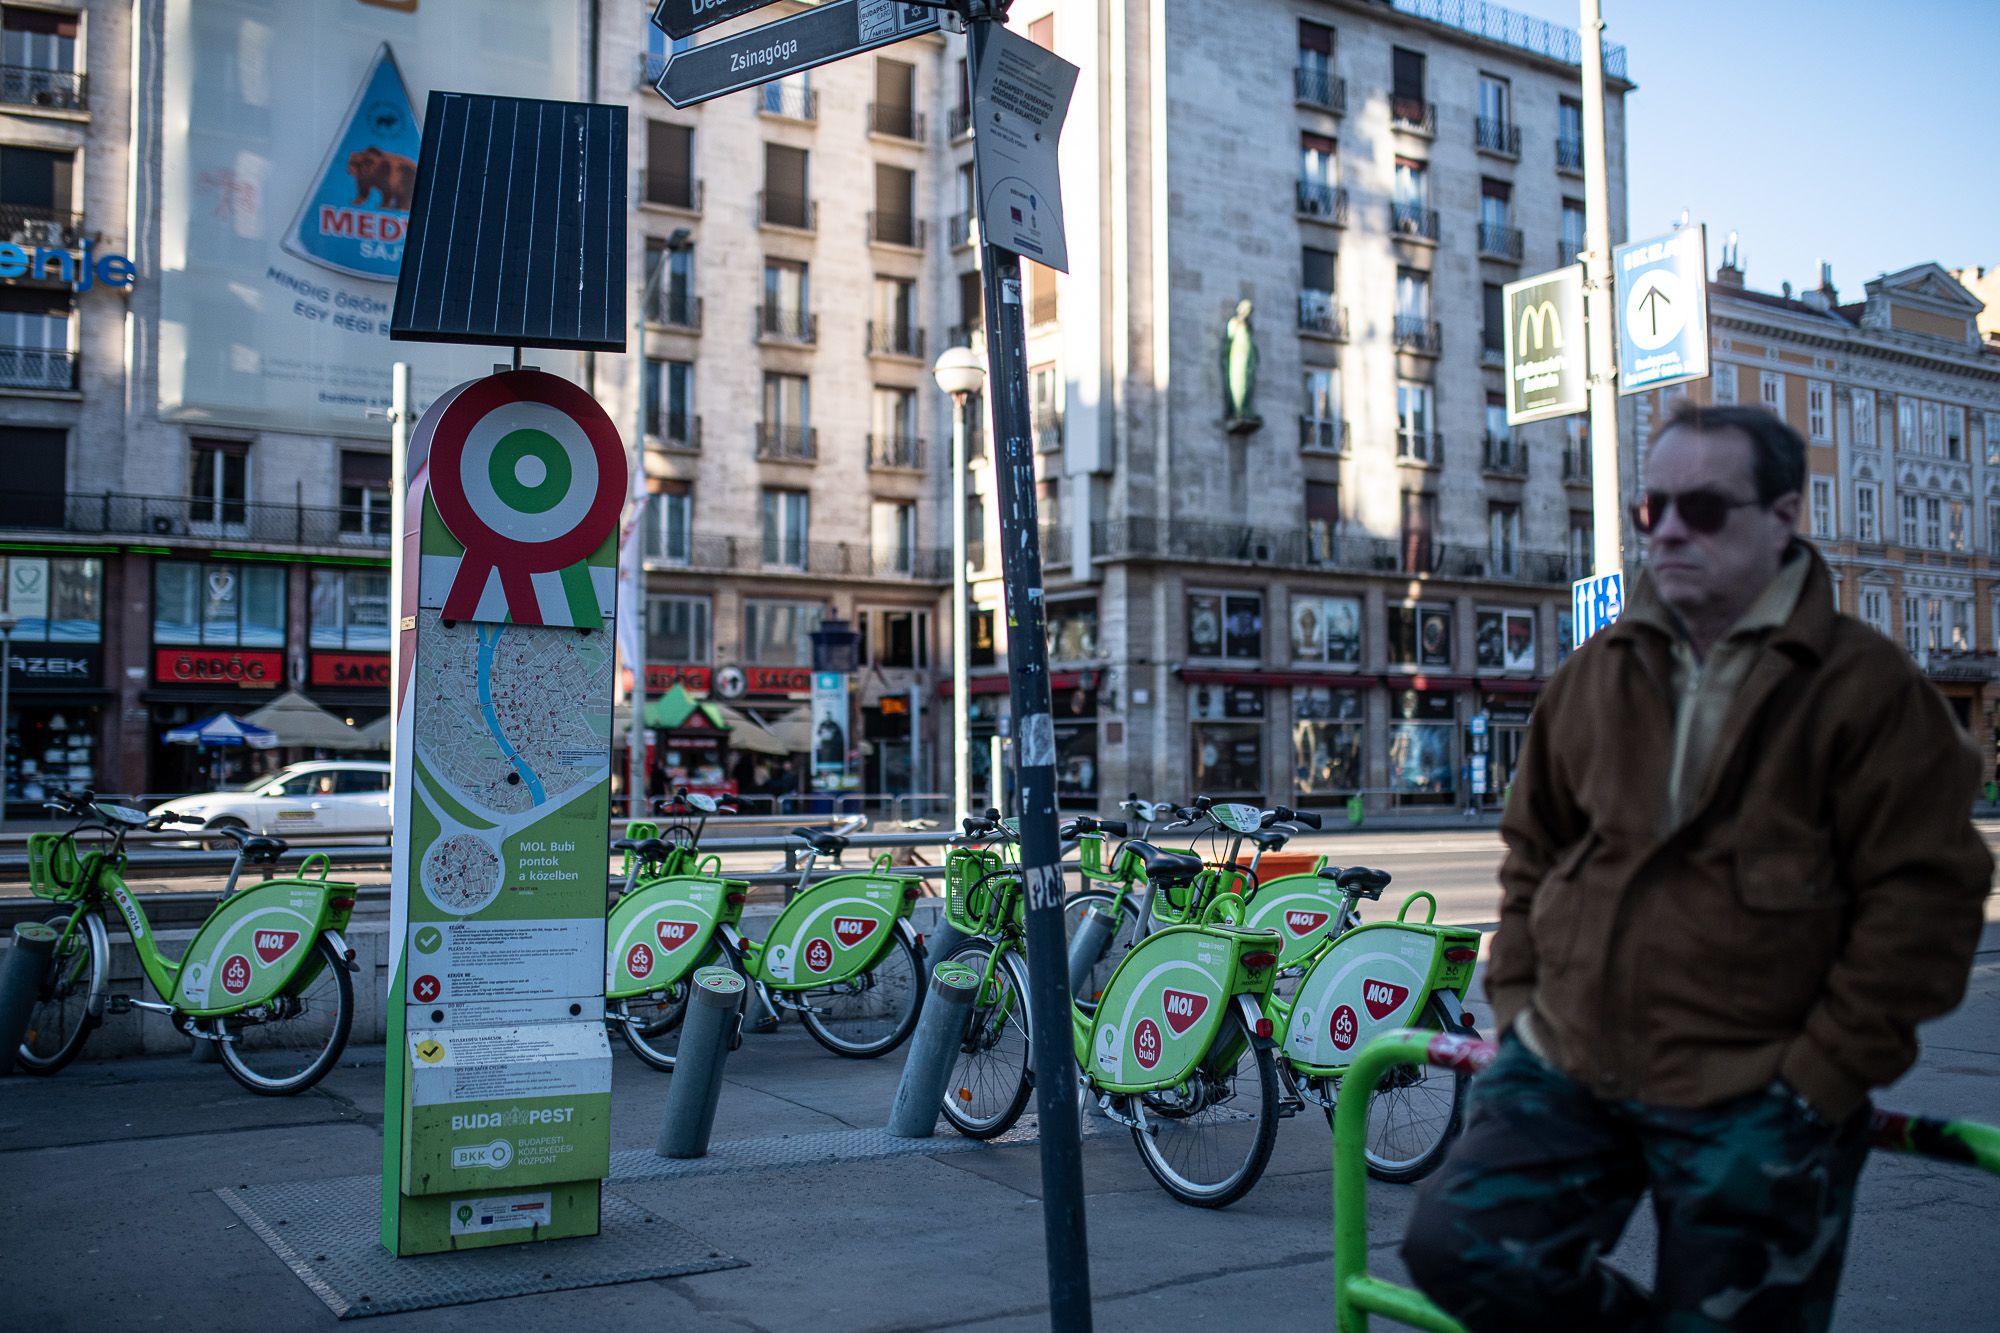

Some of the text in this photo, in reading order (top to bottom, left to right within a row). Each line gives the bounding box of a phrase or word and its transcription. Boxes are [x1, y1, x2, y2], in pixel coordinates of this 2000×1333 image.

[861, 2, 890, 19] BUDAPEST
[877, 9, 891, 20] CARD
[872, 26, 893, 37] PARTNER
[730, 38, 798, 72] Zsinagóga
[359, 241, 403, 261] SAJ
[293, 301, 328, 324] EGY
[174, 656, 266, 681] ÖRDÖG
[520, 841, 575, 852] MOL Bubi
[519, 856, 559, 869] pontok
[529, 870, 579, 881] közelben
[126, 905, 142, 932] 86214
[1289, 913, 1315, 927] MOL
[258, 934, 285, 950] MOL
[631, 964, 648, 973] bubi
[810, 958, 827, 967] bubi
[227, 979, 244, 988] bubi
[1366, 983, 1395, 1006] MOL
[1167, 995, 1193, 1017] MOL
[1334, 1030, 1351, 1044] bubi
[1139, 1049, 1155, 1062] bubi
[518, 1136, 564, 1147] BUDAPESTI
[459, 1151, 486, 1162] BKK
